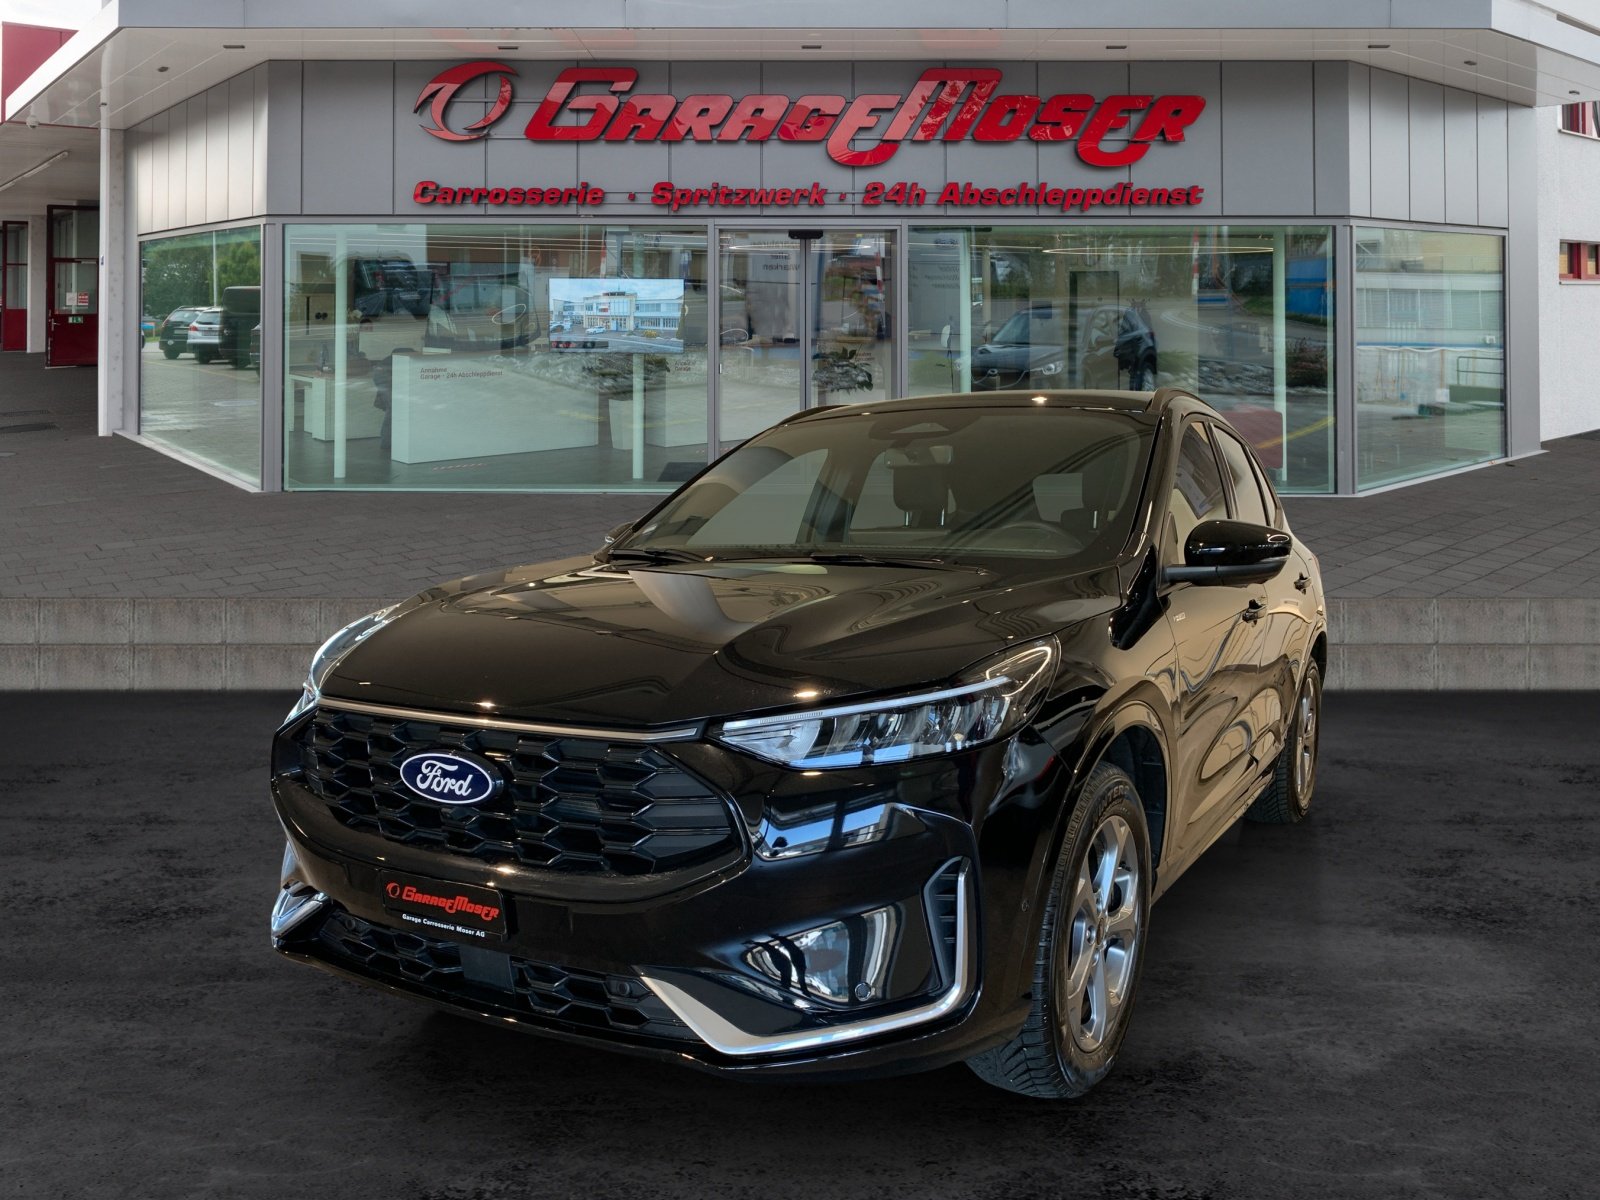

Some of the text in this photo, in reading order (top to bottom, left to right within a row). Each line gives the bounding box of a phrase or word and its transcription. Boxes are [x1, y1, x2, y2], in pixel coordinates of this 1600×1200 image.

[412, 180, 1204, 212] Carrosserie Spritzwerk 24h Abschleppdienst
[416, 759, 474, 797] Ford
[402, 913, 485, 938] Garage Carrosserie Moser AG
